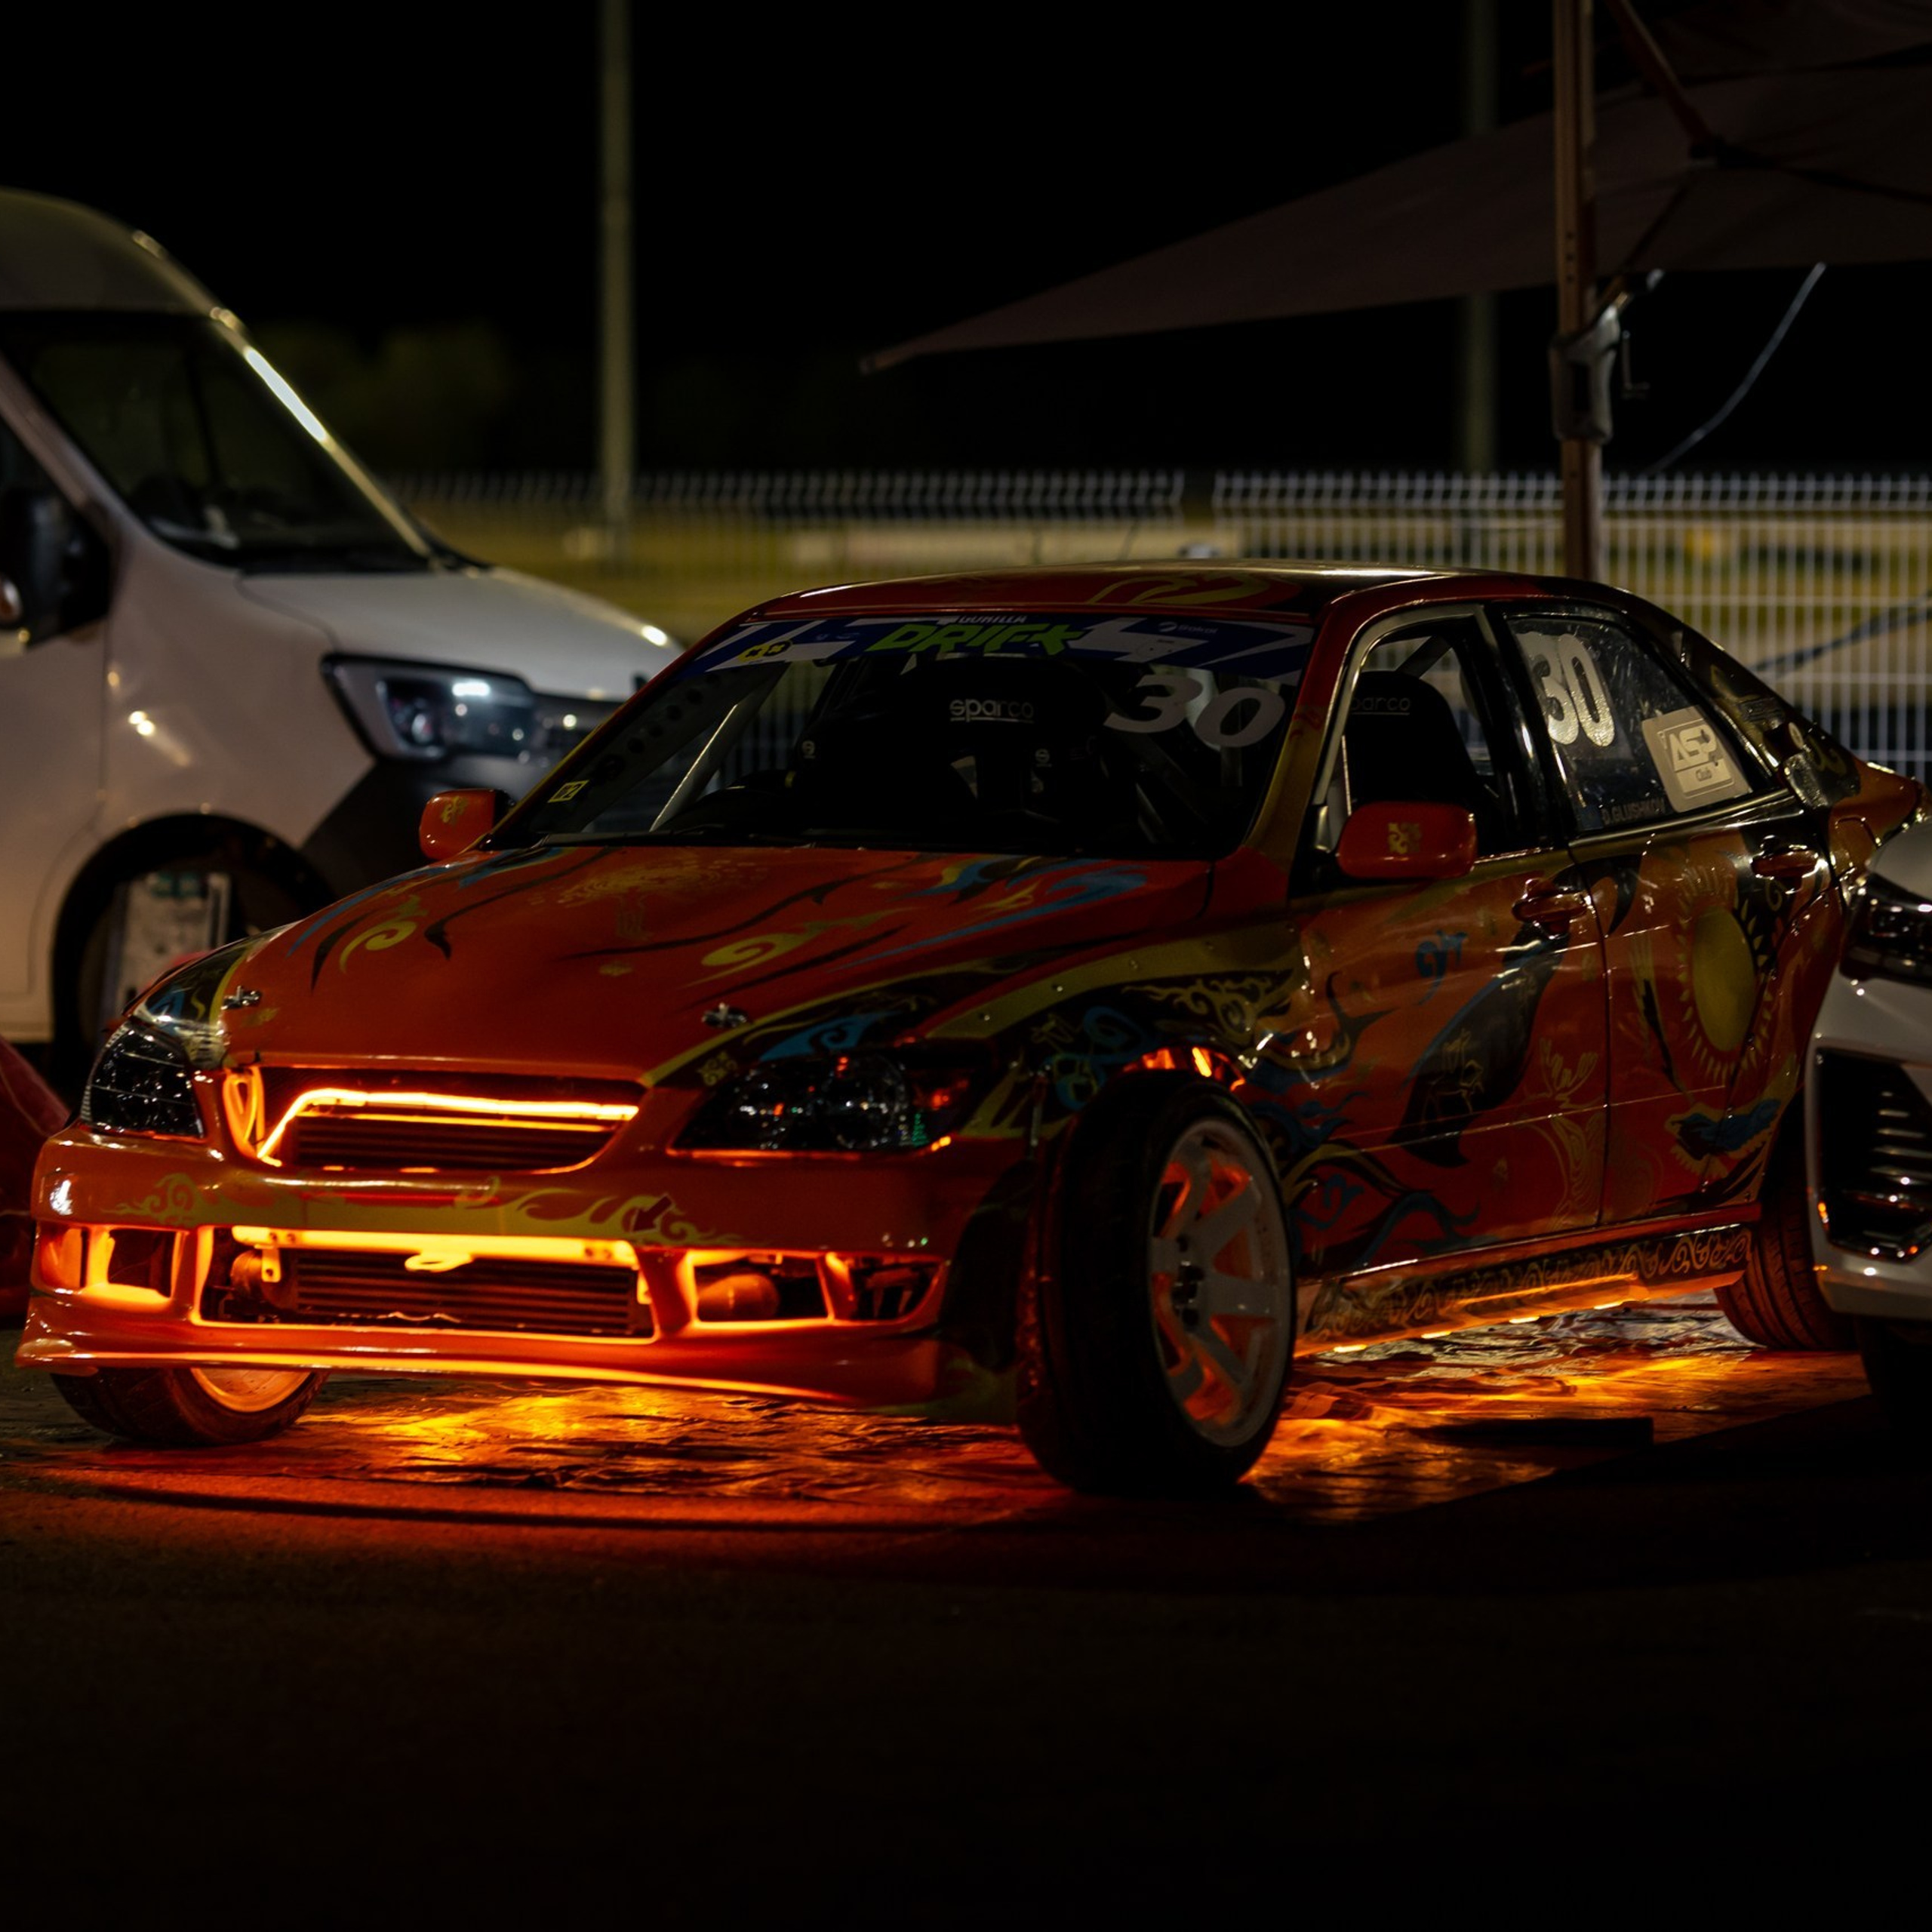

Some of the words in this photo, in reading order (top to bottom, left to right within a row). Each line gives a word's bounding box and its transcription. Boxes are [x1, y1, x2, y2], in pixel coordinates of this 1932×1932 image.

[949, 697, 1035, 724] sparco
[1103, 673, 1286, 749] 30
[1351, 696, 1412, 716] parco
[1515, 631, 1616, 747] 30
